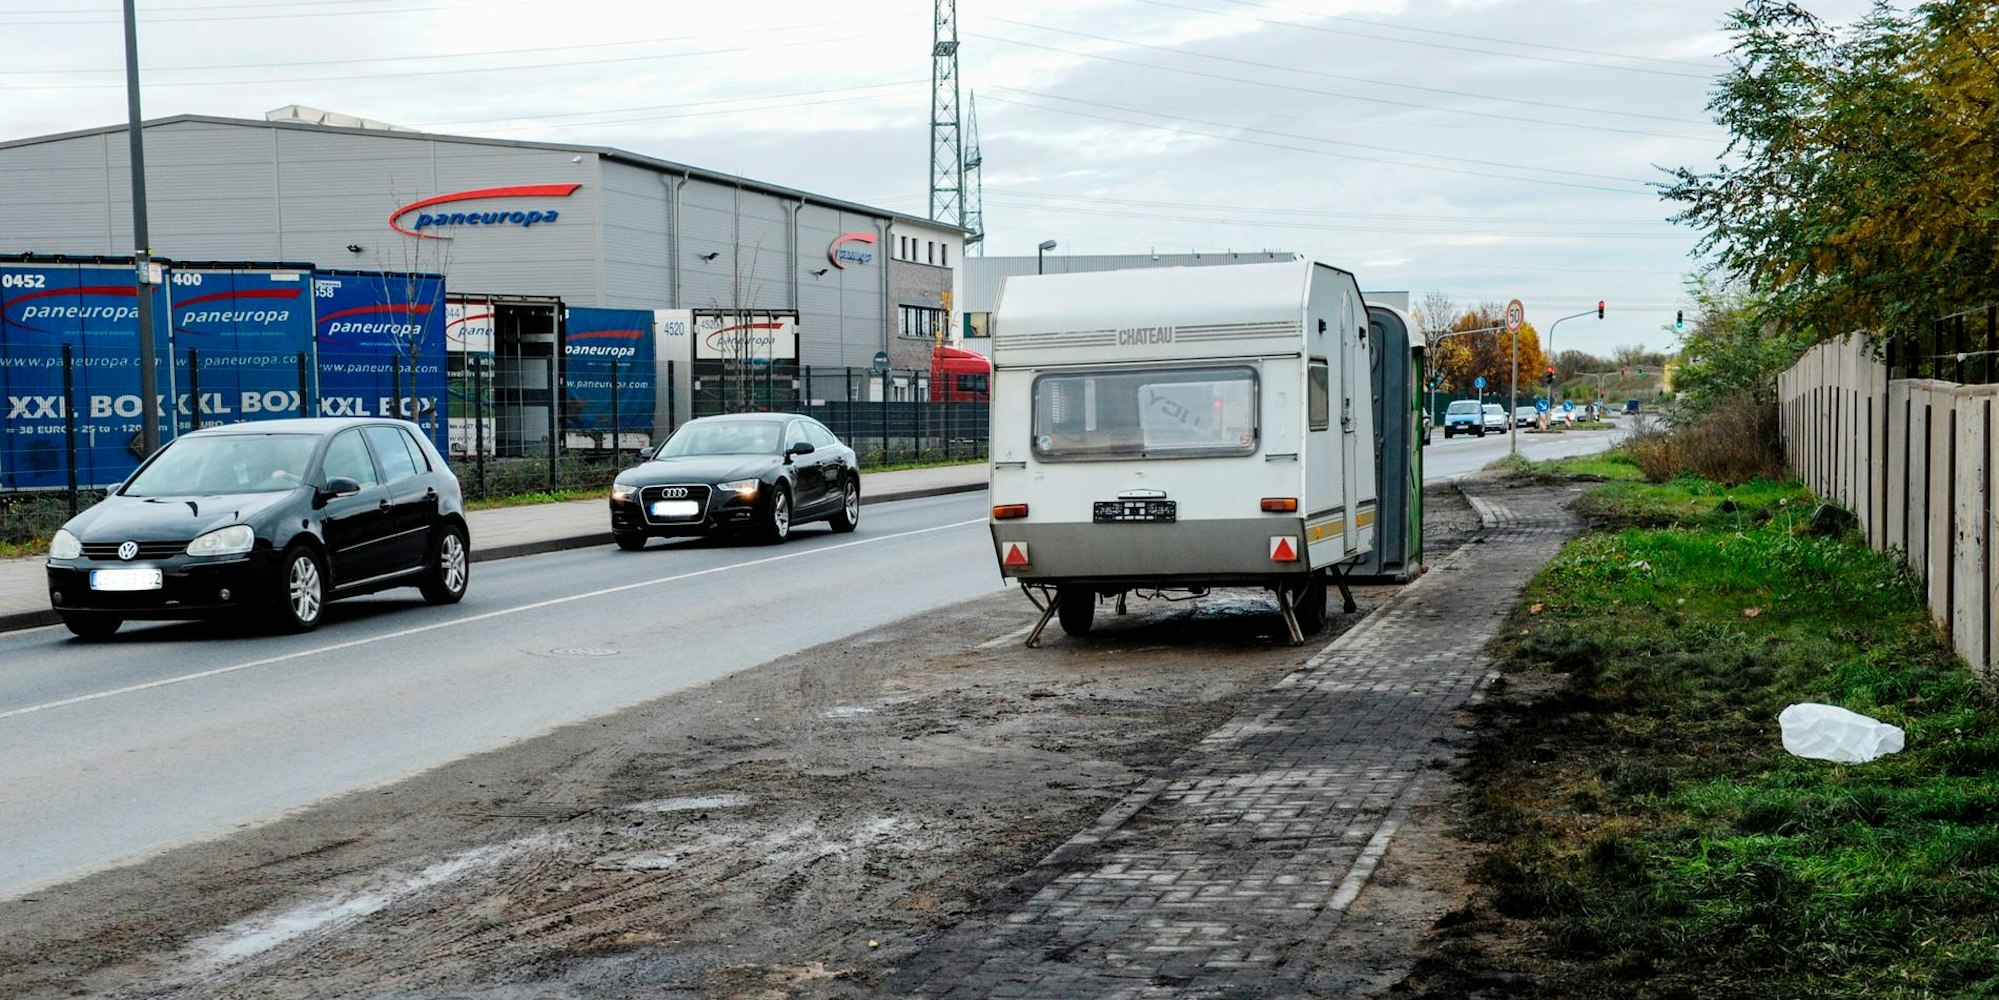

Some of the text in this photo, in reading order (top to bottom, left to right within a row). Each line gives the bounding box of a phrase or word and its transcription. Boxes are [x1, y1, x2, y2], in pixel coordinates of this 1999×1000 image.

[414, 209, 559, 230] paneuropa
[2, 274, 45, 288] 0452
[173, 273, 202, 286] 400
[22, 306, 138, 322] paneuropa
[182, 310, 289, 326] paneuropa
[1510, 308, 1520, 324] 50
[328, 322, 421, 337] paneuropa
[664, 322, 685, 336] 4520
[1119, 326, 1173, 346] CHATEAU
[0, 356, 162, 369] www.paeuropa.cm
